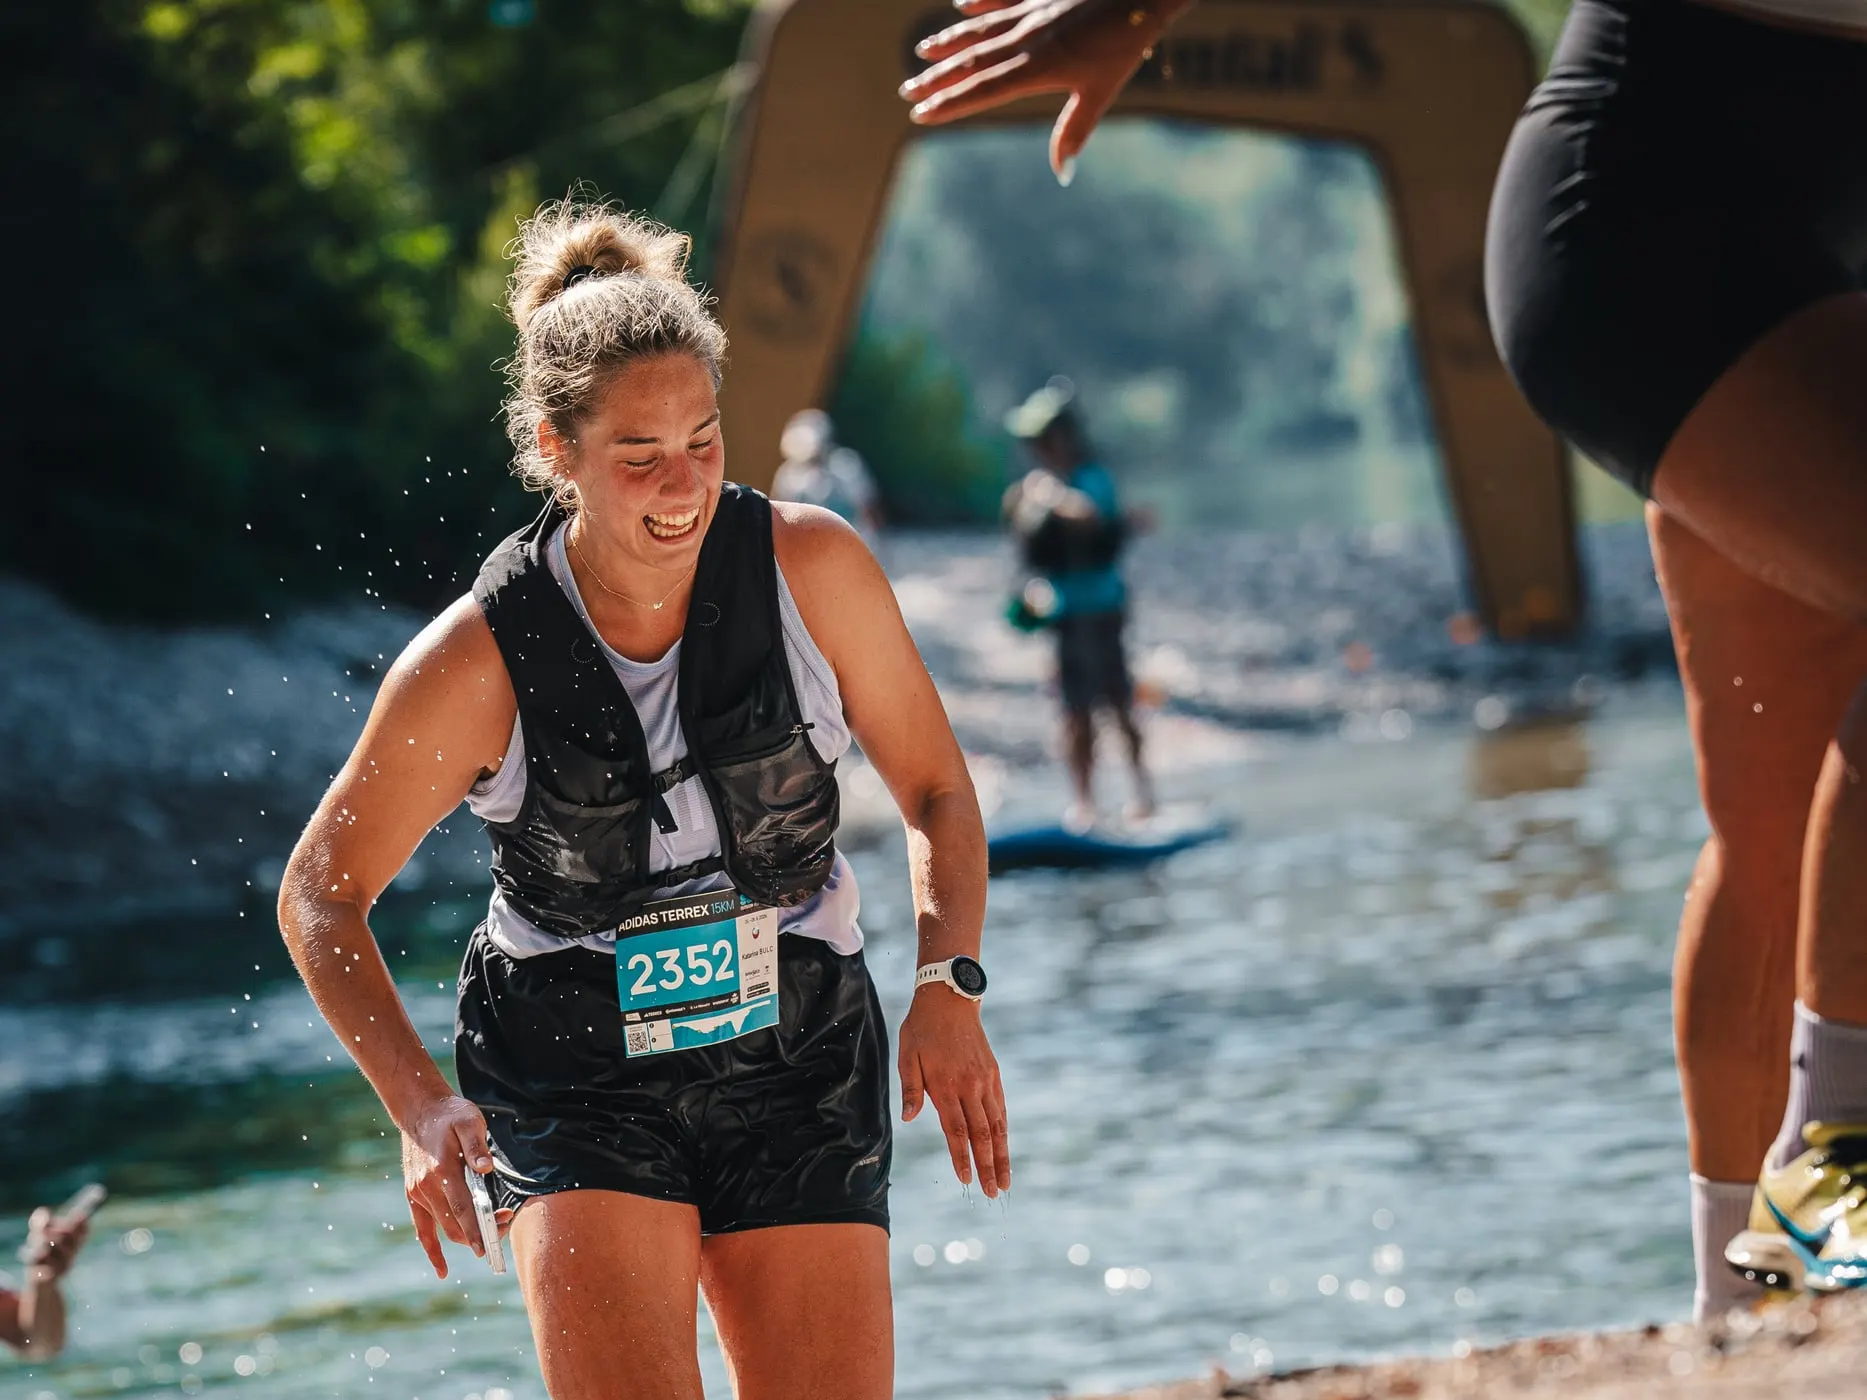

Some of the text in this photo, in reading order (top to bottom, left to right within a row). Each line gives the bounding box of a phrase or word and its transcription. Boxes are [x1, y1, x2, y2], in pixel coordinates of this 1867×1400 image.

[618, 912, 659, 932] ADIDAS
[660, 904, 709, 923] TERREX
[710, 899, 735, 915] 15KM
[627, 939, 735, 996] 2352
